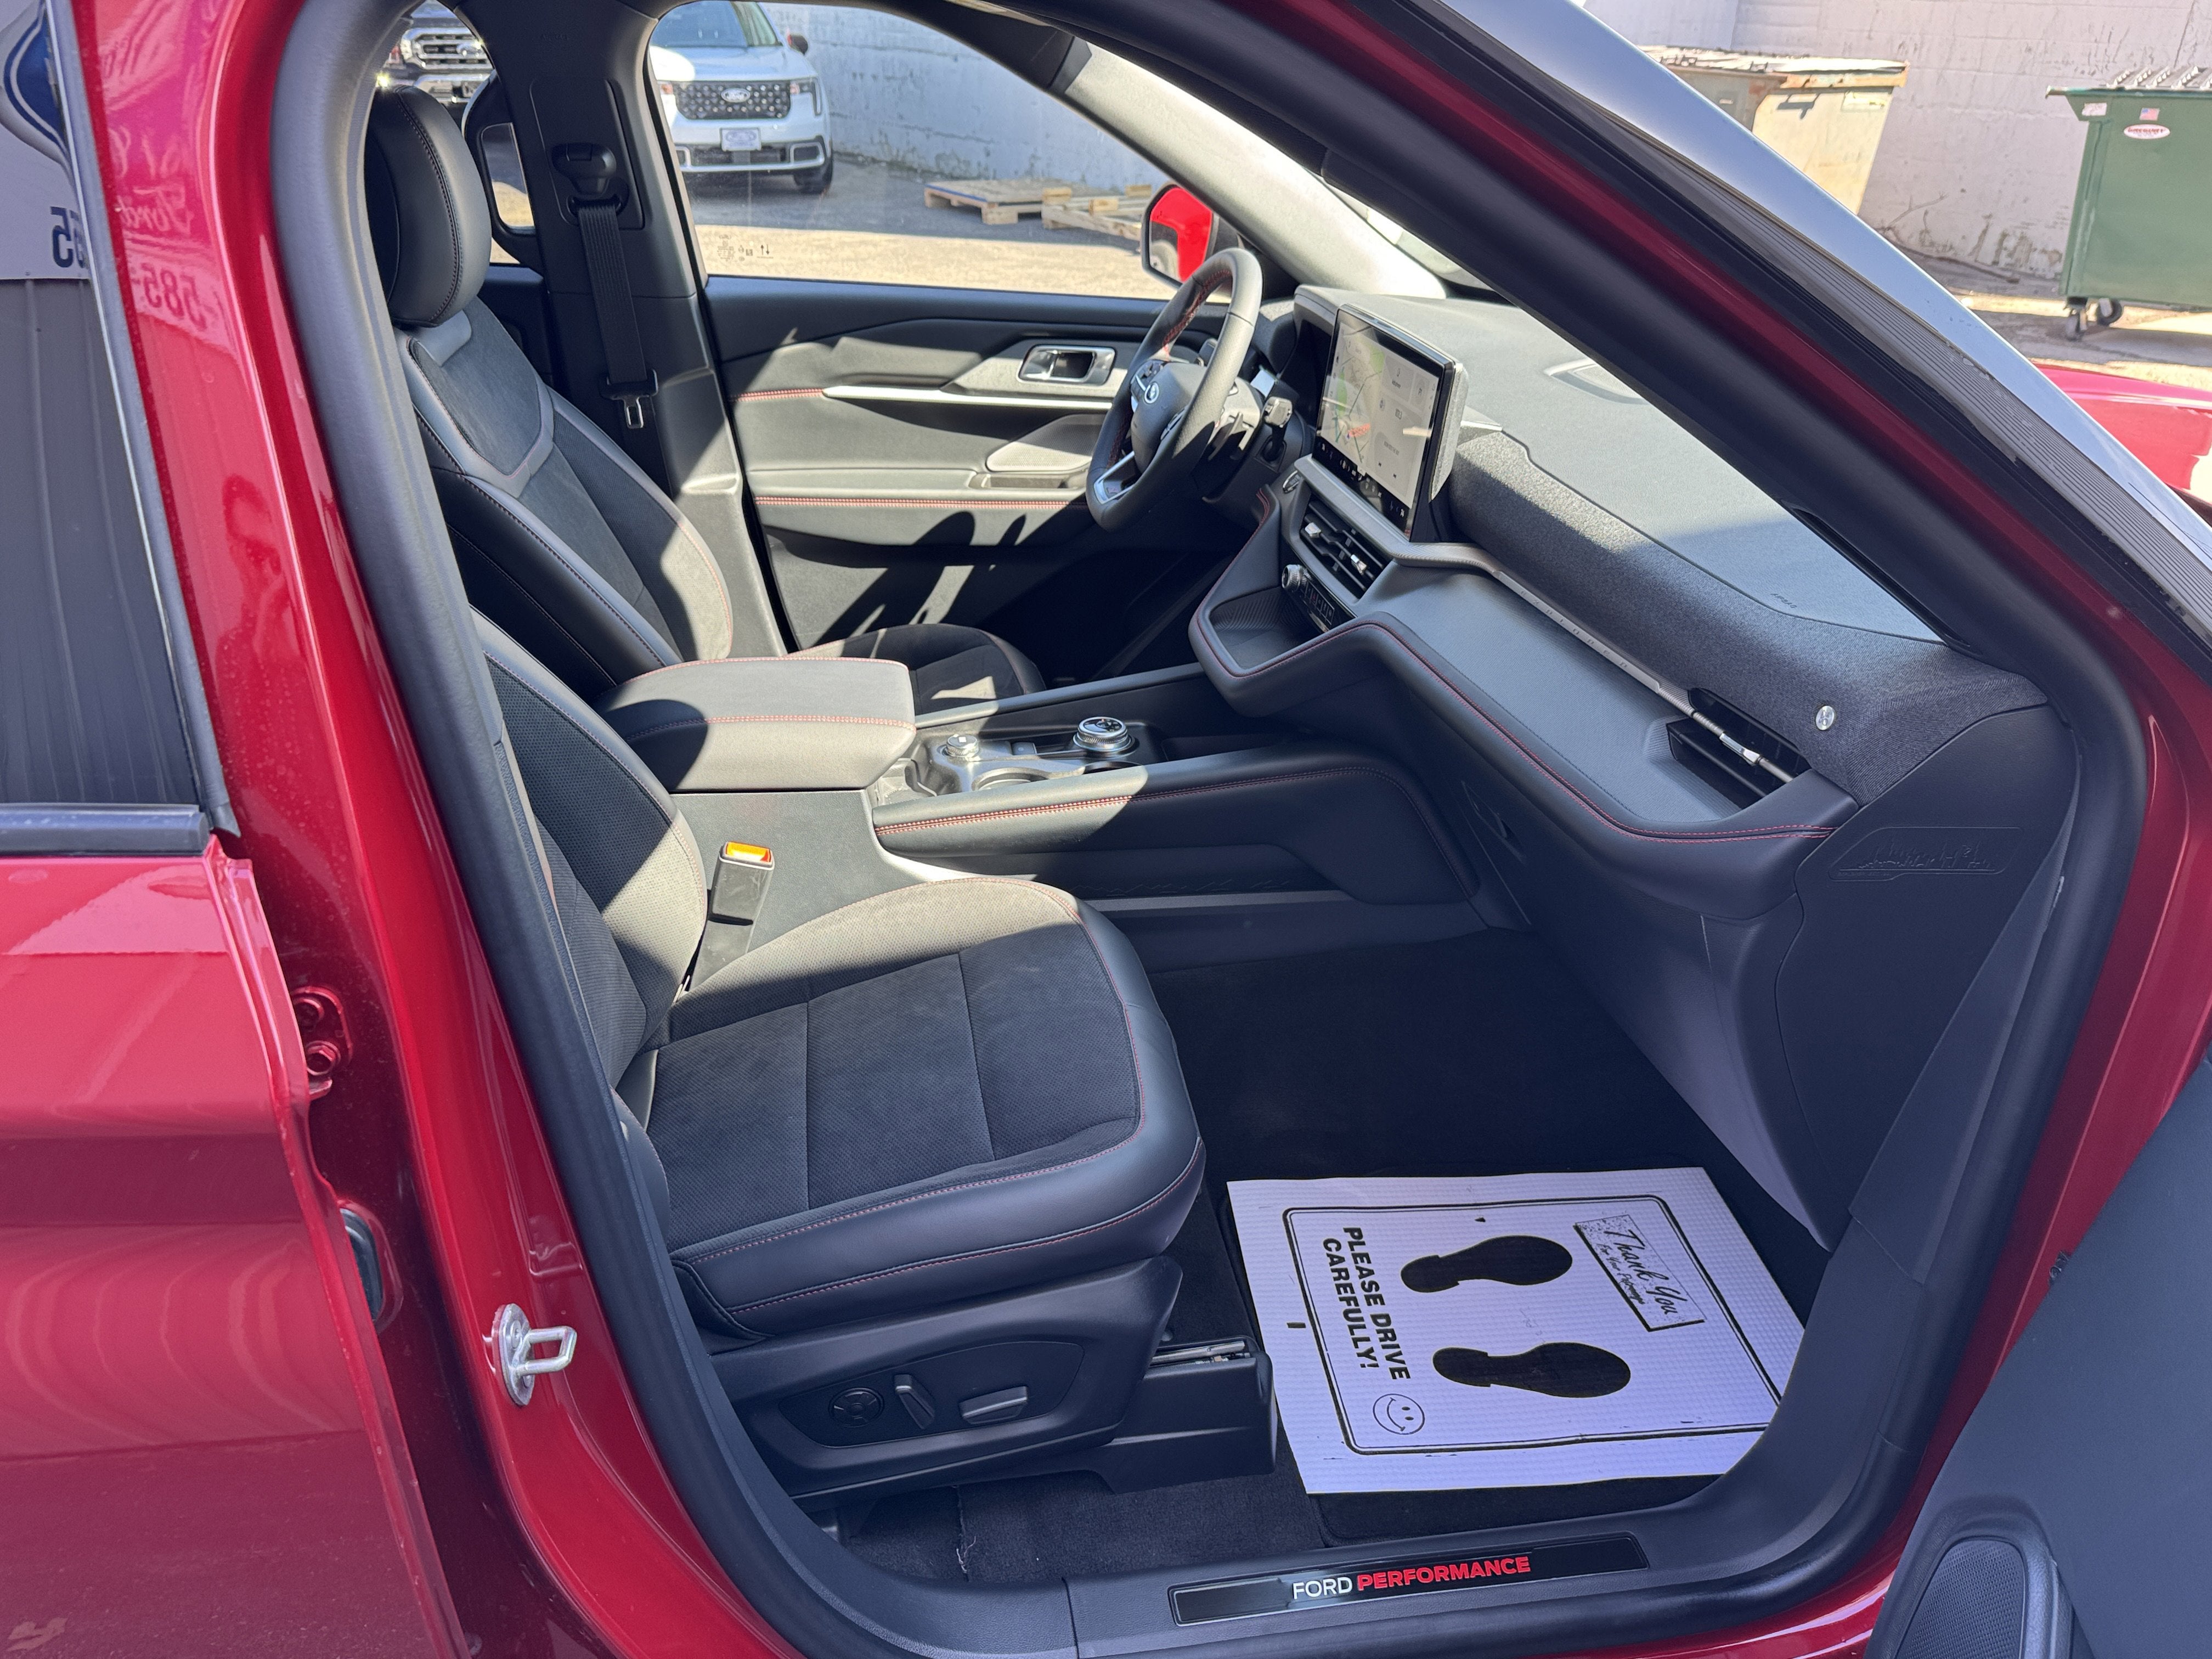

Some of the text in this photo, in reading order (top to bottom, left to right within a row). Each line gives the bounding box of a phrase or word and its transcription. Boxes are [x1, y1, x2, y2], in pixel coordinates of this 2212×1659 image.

[1323, 1238, 1379, 1368] CAREFULLY!
[1343, 1227, 1411, 1380] PLEASE DRIVE
[1604, 1229, 1688, 1315] Thank You
[1293, 1556, 1531, 1600] FORD PERFORMANCE
